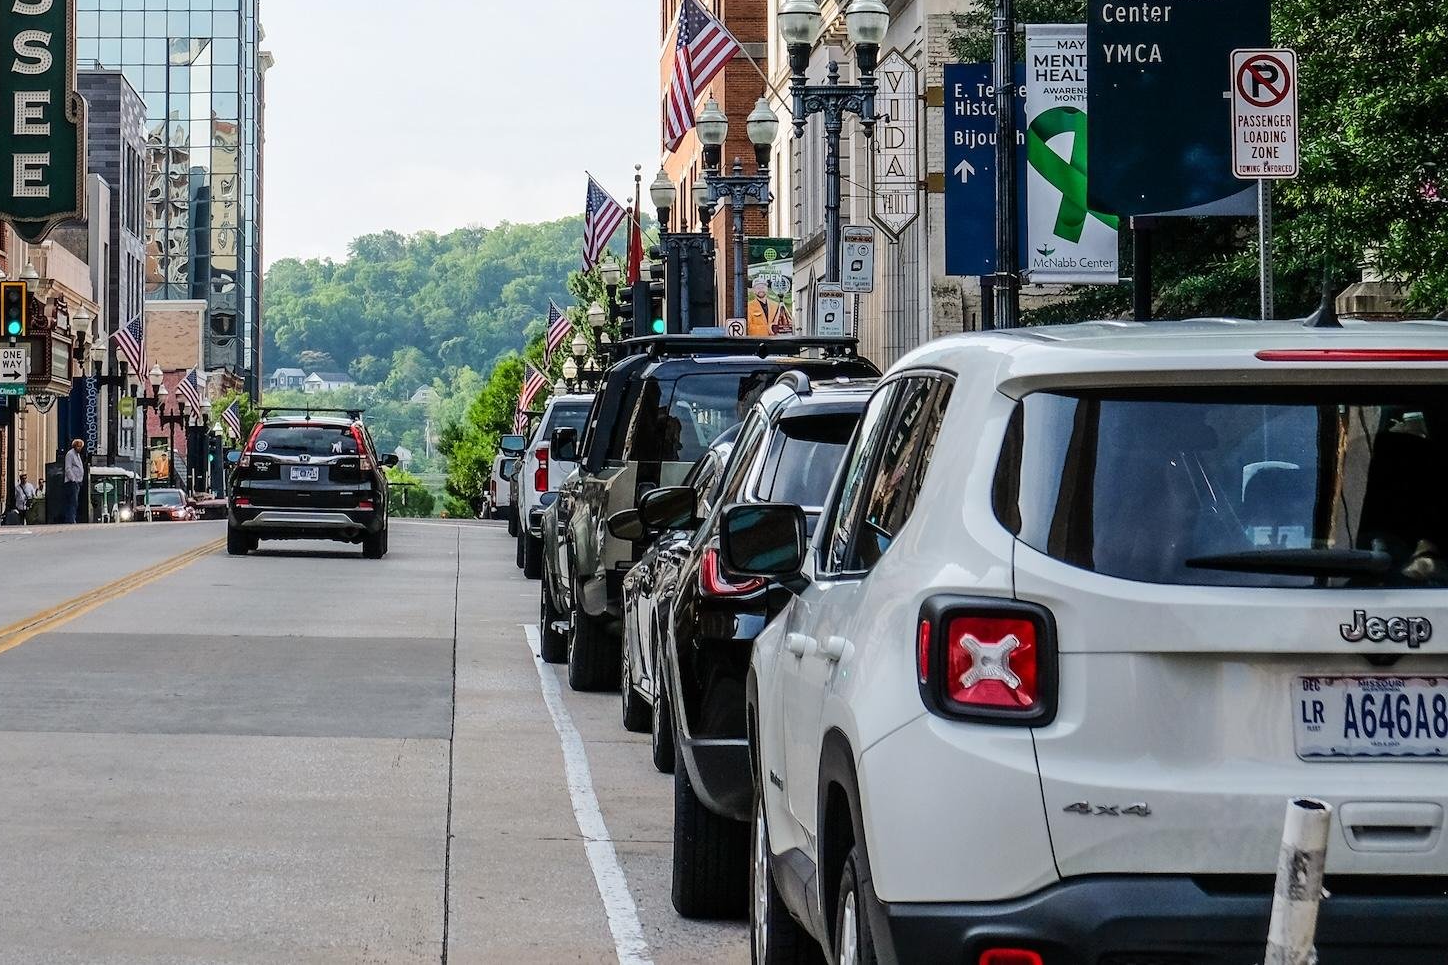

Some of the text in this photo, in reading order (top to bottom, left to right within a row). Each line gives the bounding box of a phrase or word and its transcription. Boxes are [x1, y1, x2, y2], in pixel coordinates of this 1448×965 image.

[1102, 2, 1172, 23] Center
[1057, 40, 1086, 50] MAY
[1103, 43, 1163, 63] YMCA
[1034, 54, 1087, 67] MENT
[1036, 69, 1087, 82] HEAL
[954, 83, 968, 98] E.
[884, 71, 906, 177] VIDA
[1238, 114, 1292, 127] PASSENGER
[954, 129, 997, 149] Bijou
[1243, 131, 1287, 143] LOADING
[1251, 146, 1280, 159] ZONE
[1239, 164, 1293, 173] TOWING ENFORCED
[1033, 257, 1114, 268] McNabb Center
[758, 273, 783, 283] OPEN
[3, 350, 22, 359] ONE
[2, 360, 22, 368] WAY
[1339, 609, 1433, 649] Jeep
[1302, 678, 1321, 691] DEC
[1357, 678, 1407, 688] MISSOURI
[1301, 700, 1325, 724] LR
